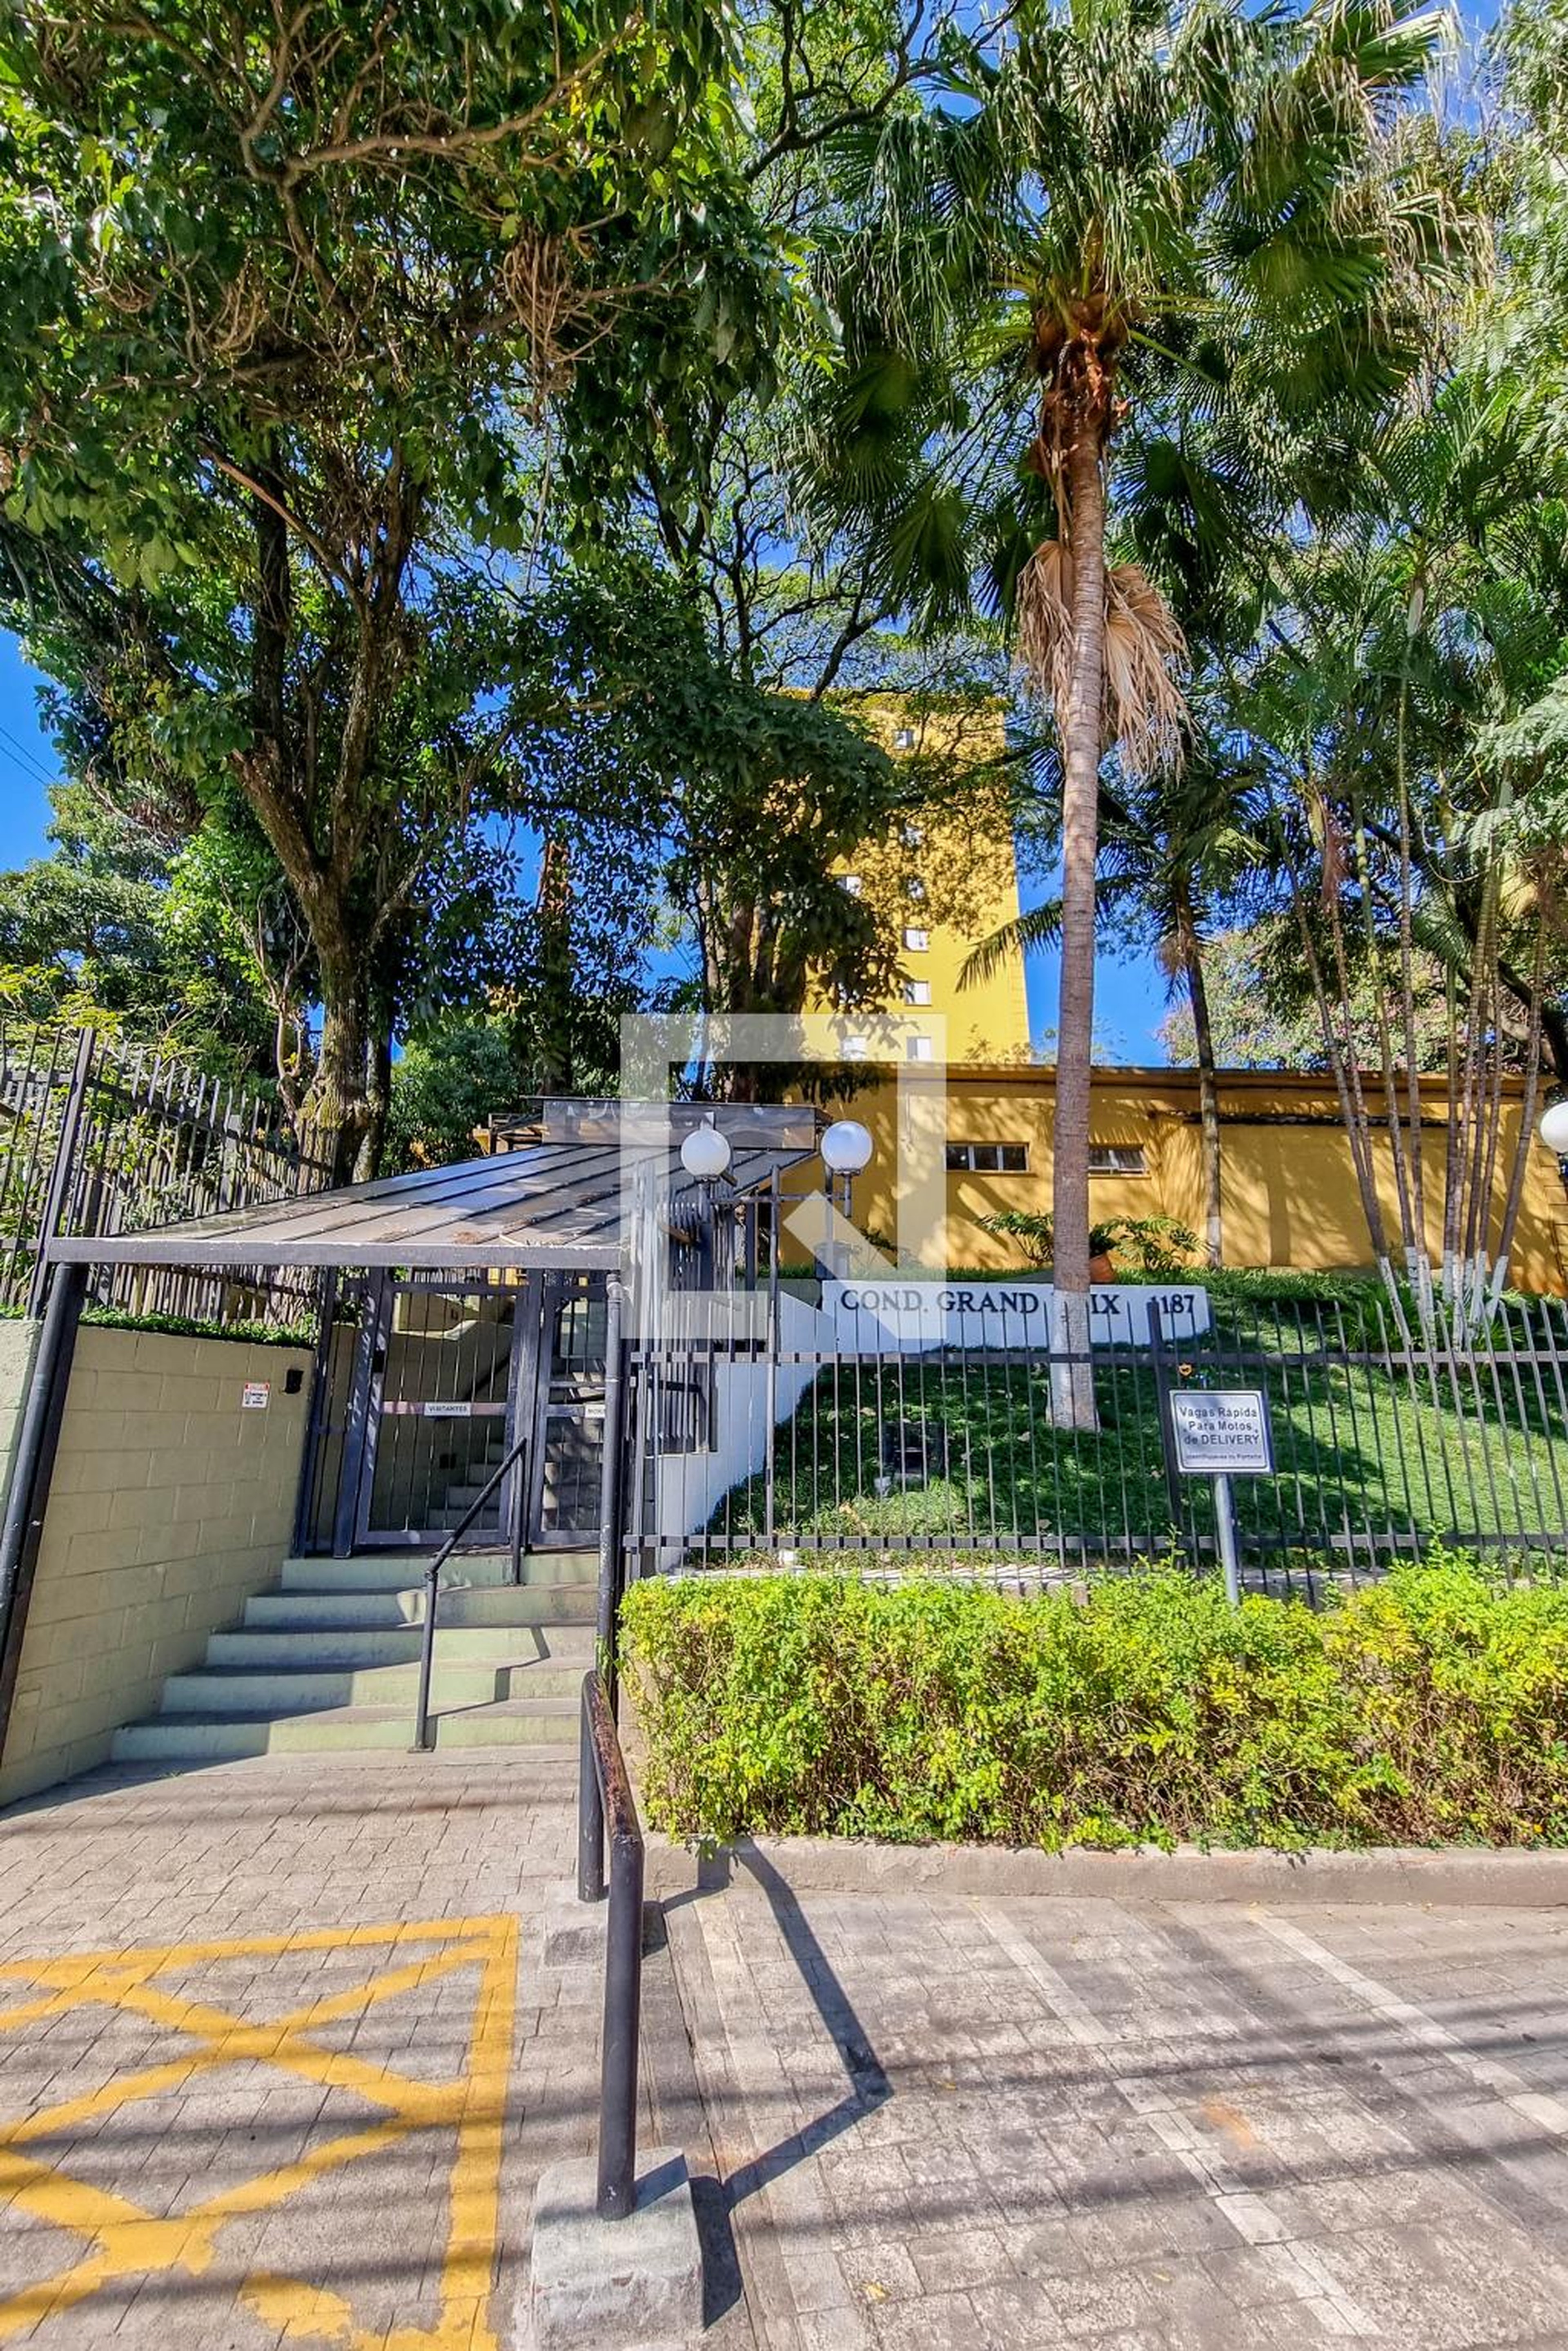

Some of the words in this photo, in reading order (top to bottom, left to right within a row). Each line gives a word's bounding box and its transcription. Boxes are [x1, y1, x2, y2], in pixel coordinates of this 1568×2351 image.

[840, 1289, 928, 1312] COND.
[937, 1290, 1039, 1314] GRAND
[1179, 1407, 1215, 1419] Vagas
[1189, 1421, 1215, 1430] Para
[1184, 1434, 1198, 1445] de
[1201, 1434, 1260, 1445] DELIVERY
